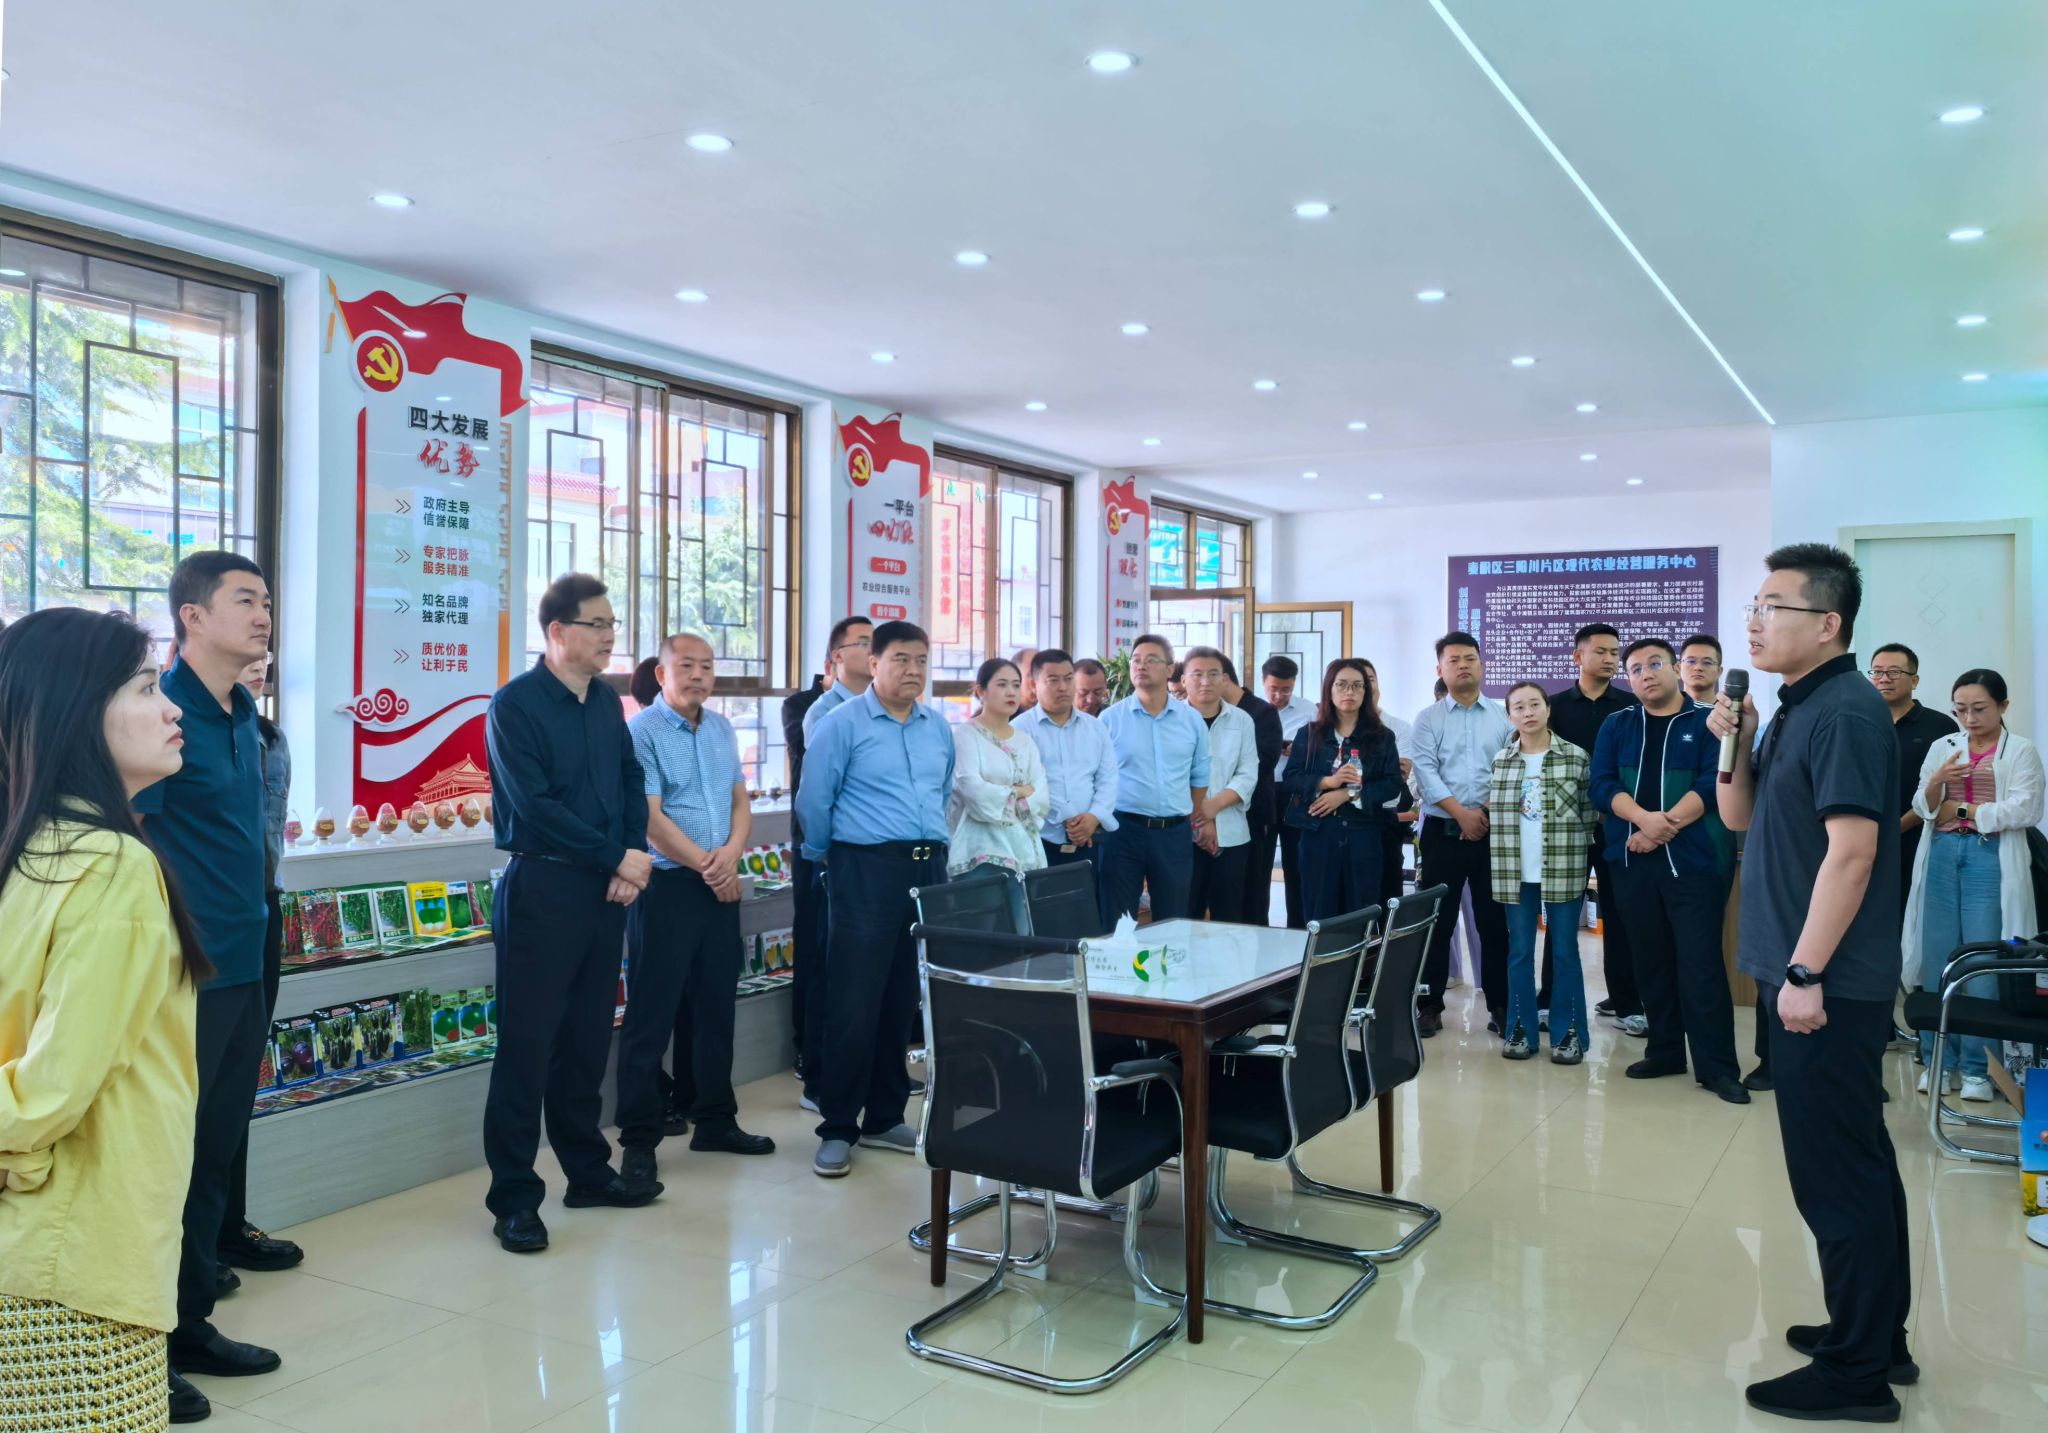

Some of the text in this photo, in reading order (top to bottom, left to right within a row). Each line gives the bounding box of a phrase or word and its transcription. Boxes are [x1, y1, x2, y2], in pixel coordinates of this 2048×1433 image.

[409, 406, 488, 440] 四大发展
[418, 438, 480, 478] 优势
[423, 496, 470, 514] 政府主导
[884, 499, 914, 517] 一平台
[423, 511, 470, 530] 信誉保障
[423, 544, 469, 561] 专家把脉
[423, 561, 469, 577] 服务精准
[877, 560, 901, 572] 一个平台
[862, 581, 911, 596] 农业综合服务平台
[422, 593, 469, 609] 知名品牌
[422, 609, 469, 625] 独家代理
[422, 642, 468, 656] 质优价廉
[421, 658, 468, 673] 让利于民
